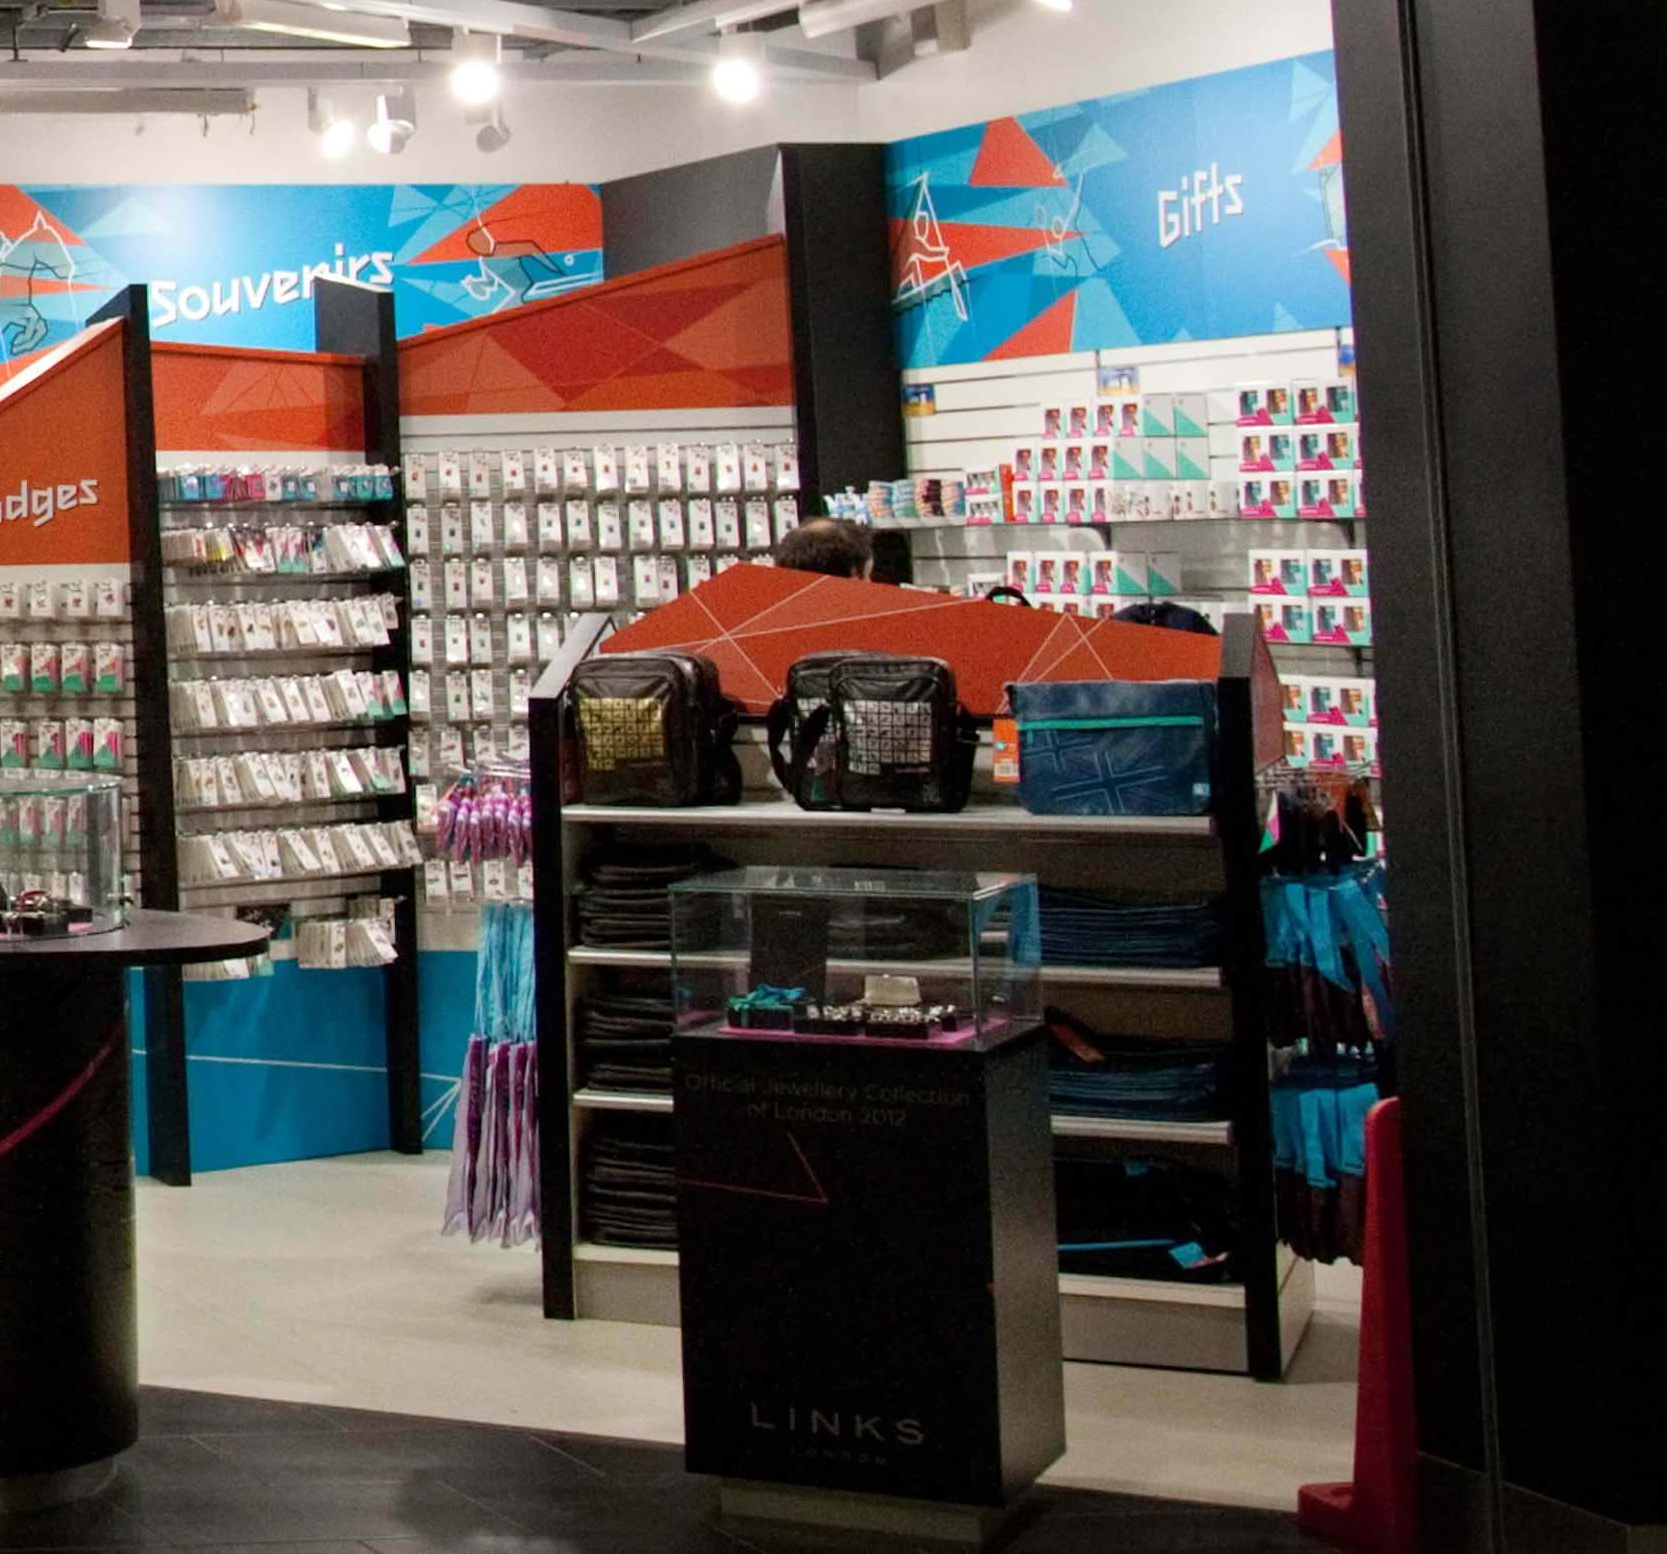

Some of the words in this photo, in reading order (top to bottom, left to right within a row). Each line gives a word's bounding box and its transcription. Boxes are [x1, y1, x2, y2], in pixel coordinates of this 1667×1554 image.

[1157, 160, 1244, 249] Gifts
[150, 242, 395, 328] Souvenirs
[762, 1076, 858, 1104] Jewellery
[864, 1082, 971, 1108] Collection
[772, 1100, 853, 1124] London
[856, 1106, 908, 1128] 2012
[750, 1399, 925, 1447] LINKS
